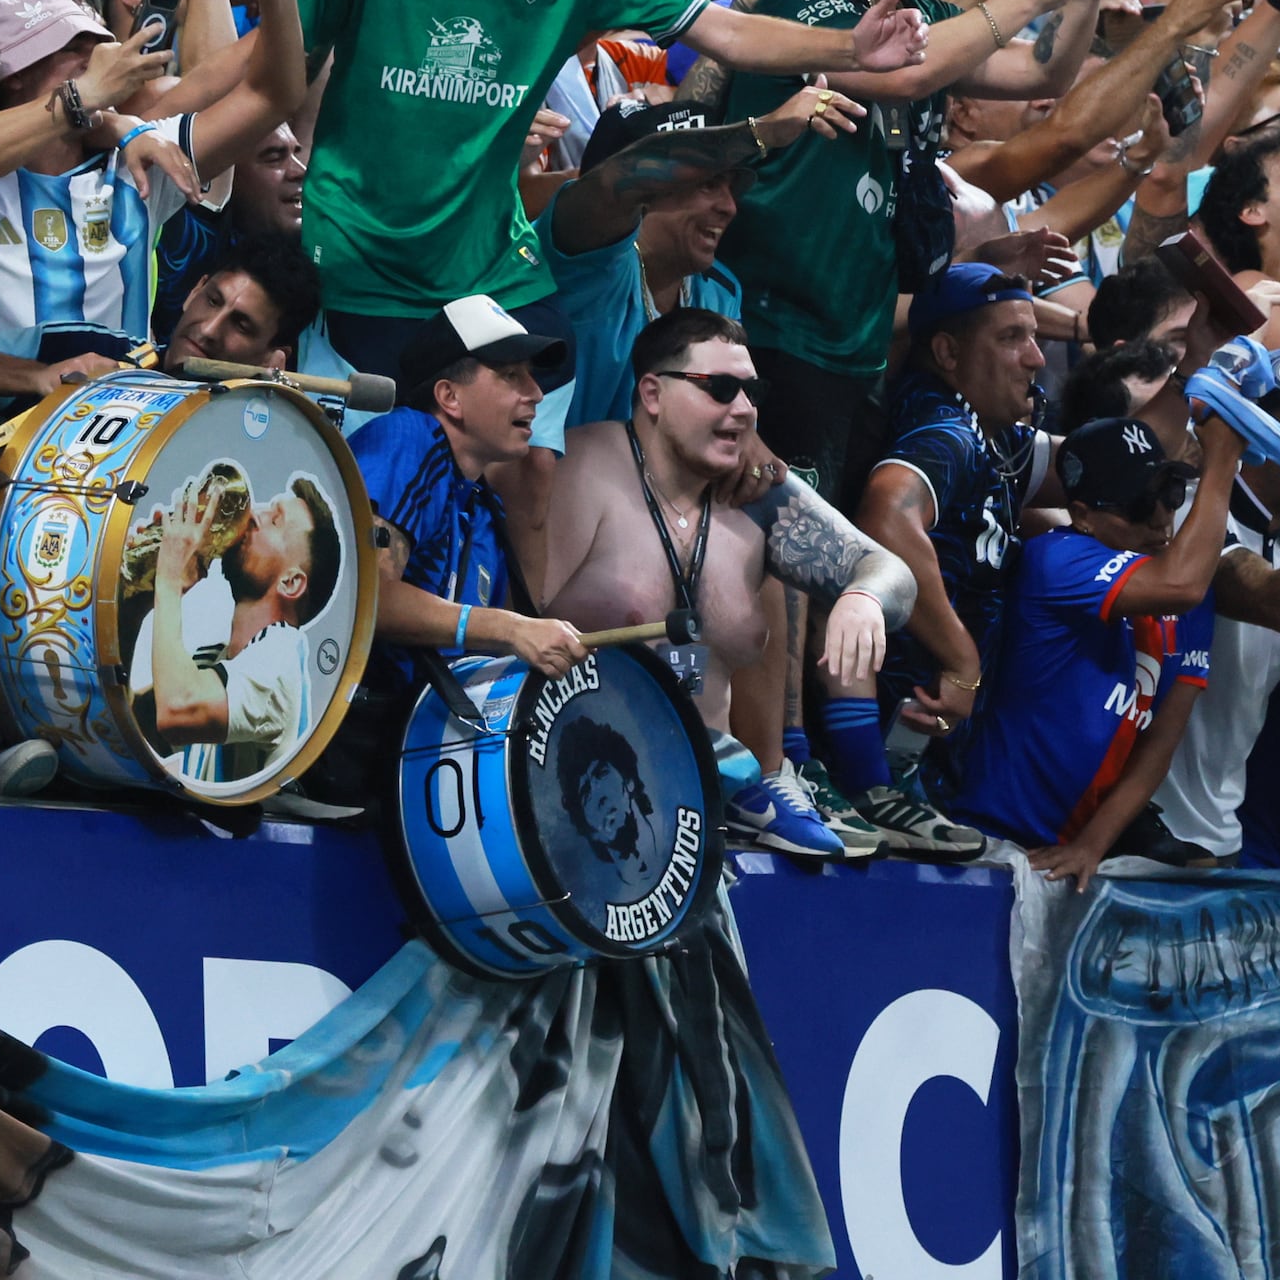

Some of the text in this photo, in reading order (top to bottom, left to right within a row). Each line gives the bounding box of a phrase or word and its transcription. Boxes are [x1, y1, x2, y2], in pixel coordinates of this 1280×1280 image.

[24, 11, 52, 29] adidas
[380, 66, 529, 108] KIRANIMPORT
[86, 387, 178, 410] ARGENTINA
[78, 414, 130, 445] 10
[1122, 424, 1152, 453] NY
[528, 654, 600, 766] HINCHAS
[604, 808, 700, 942] ARGENTINOS
